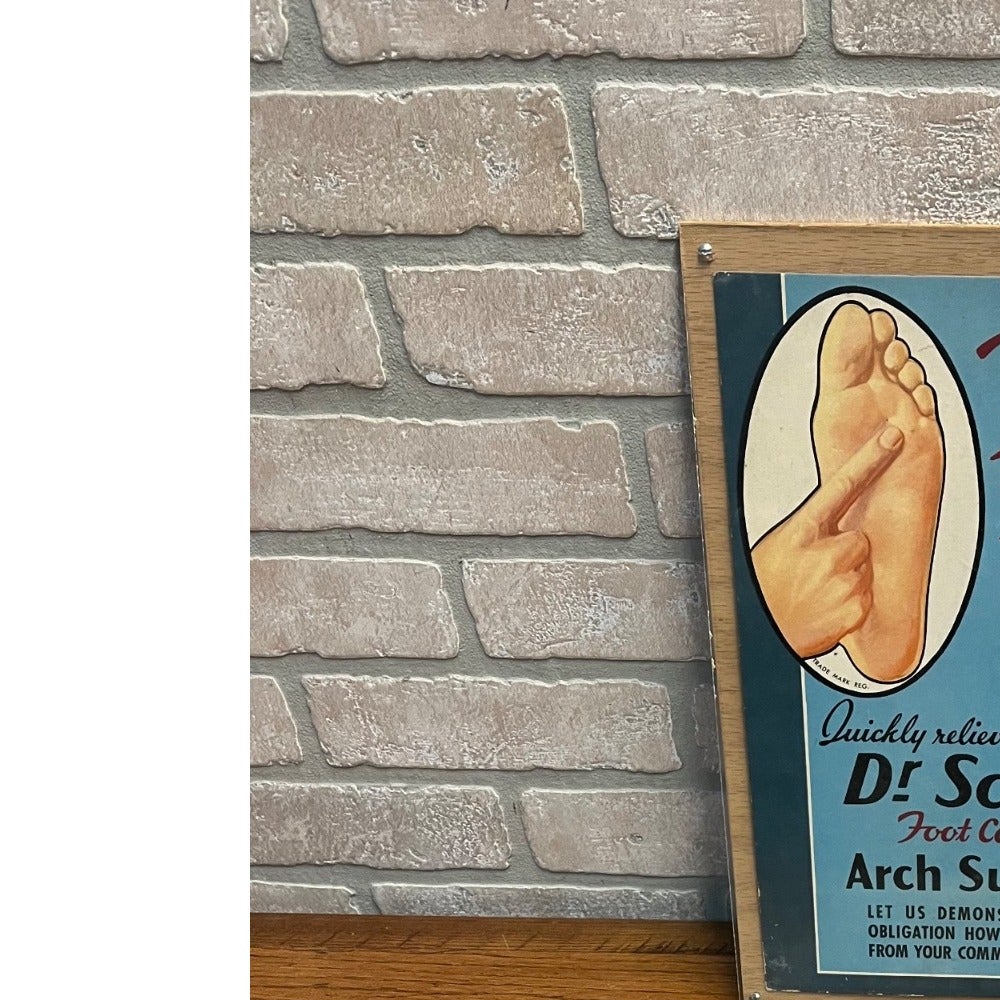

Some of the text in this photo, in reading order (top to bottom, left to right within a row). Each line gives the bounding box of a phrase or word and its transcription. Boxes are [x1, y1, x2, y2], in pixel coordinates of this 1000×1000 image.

[832, 674, 850, 685] MARK
[819, 699, 928, 753] Quickly
[897, 811, 972, 845] Foot
[846, 853, 941, 891] Arch
[867, 905, 892, 919] LET
[905, 906, 926, 920] US
[868, 925, 955, 940] OBLIGATION
[965, 927, 1000, 941] HOW
[869, 944, 908, 959] FROM
[914, 945, 951, 959] YOUR
